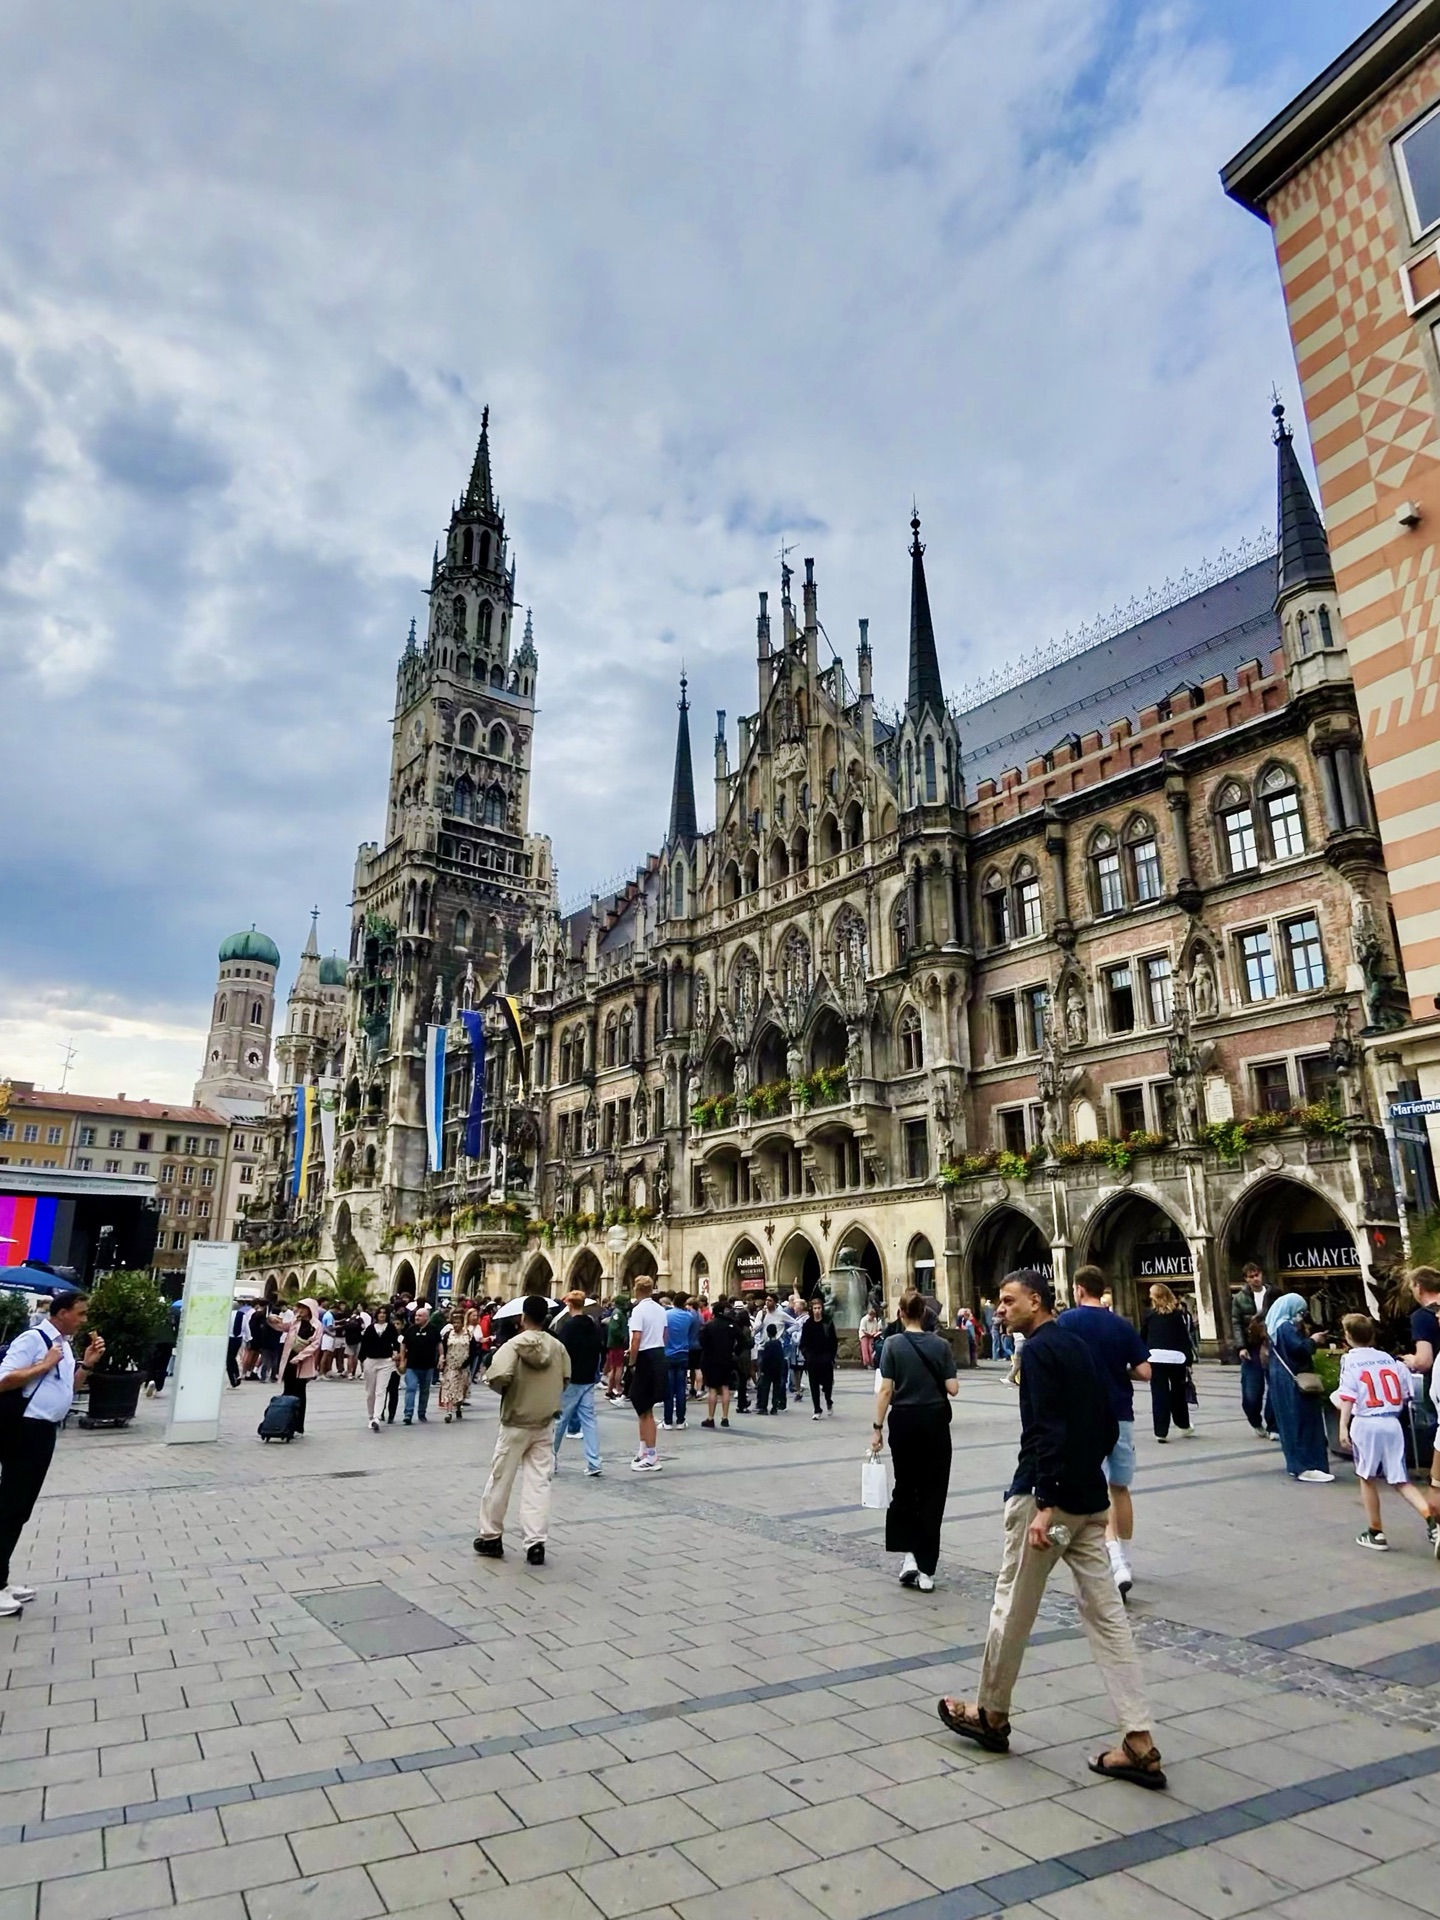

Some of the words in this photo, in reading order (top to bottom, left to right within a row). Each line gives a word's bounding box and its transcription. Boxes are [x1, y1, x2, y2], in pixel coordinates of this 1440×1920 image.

[442, 1262, 451, 1273] S
[441, 1276, 450, 1288] U
[1360, 1367, 1402, 1408] 10
